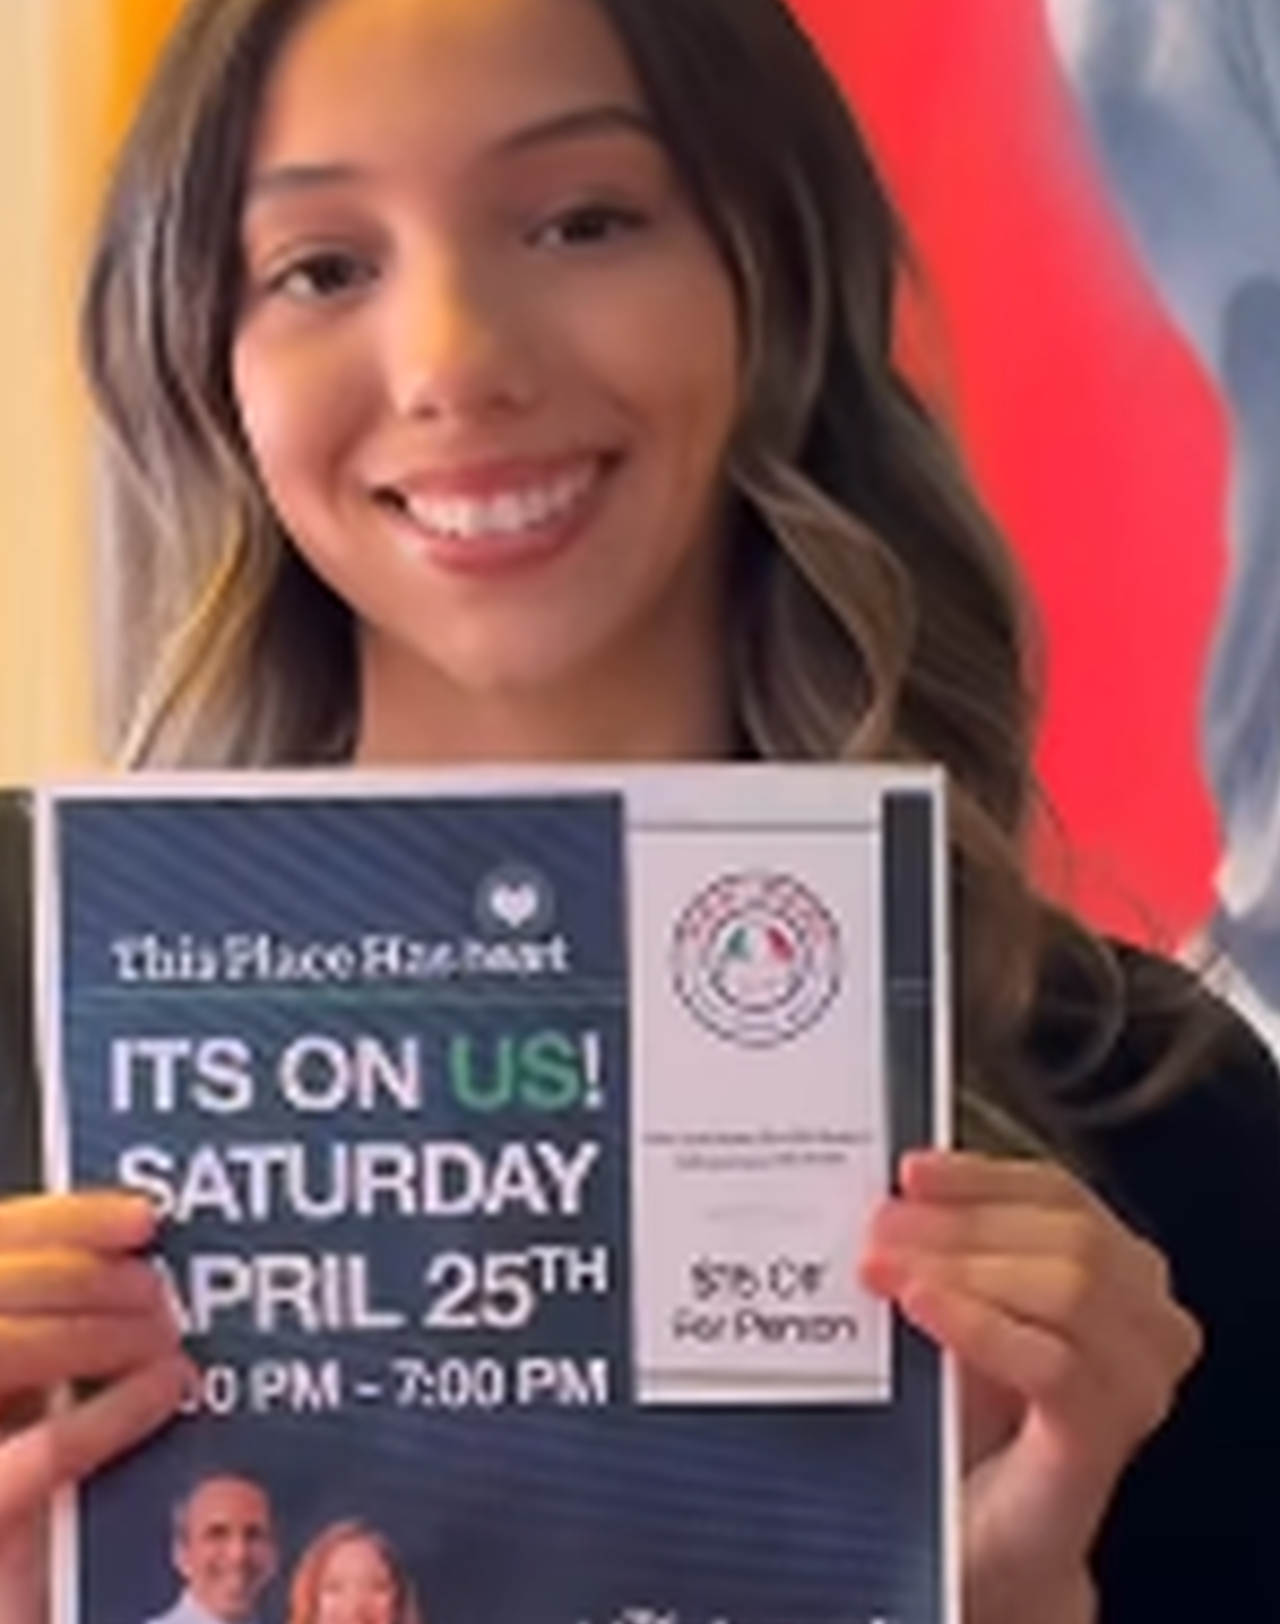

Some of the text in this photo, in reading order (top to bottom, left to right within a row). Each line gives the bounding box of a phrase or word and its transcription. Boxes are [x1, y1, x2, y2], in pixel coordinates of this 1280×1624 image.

[112, 932, 217, 981] This
[223, 932, 356, 981] Place
[111, 1030, 604, 1113] ITS ON US!
[118, 1142, 600, 1222] SATURDAY
[252, 1361, 340, 1409] PM
[395, 1358, 503, 1406] 7:00
[520, 1356, 606, 1404] PM
